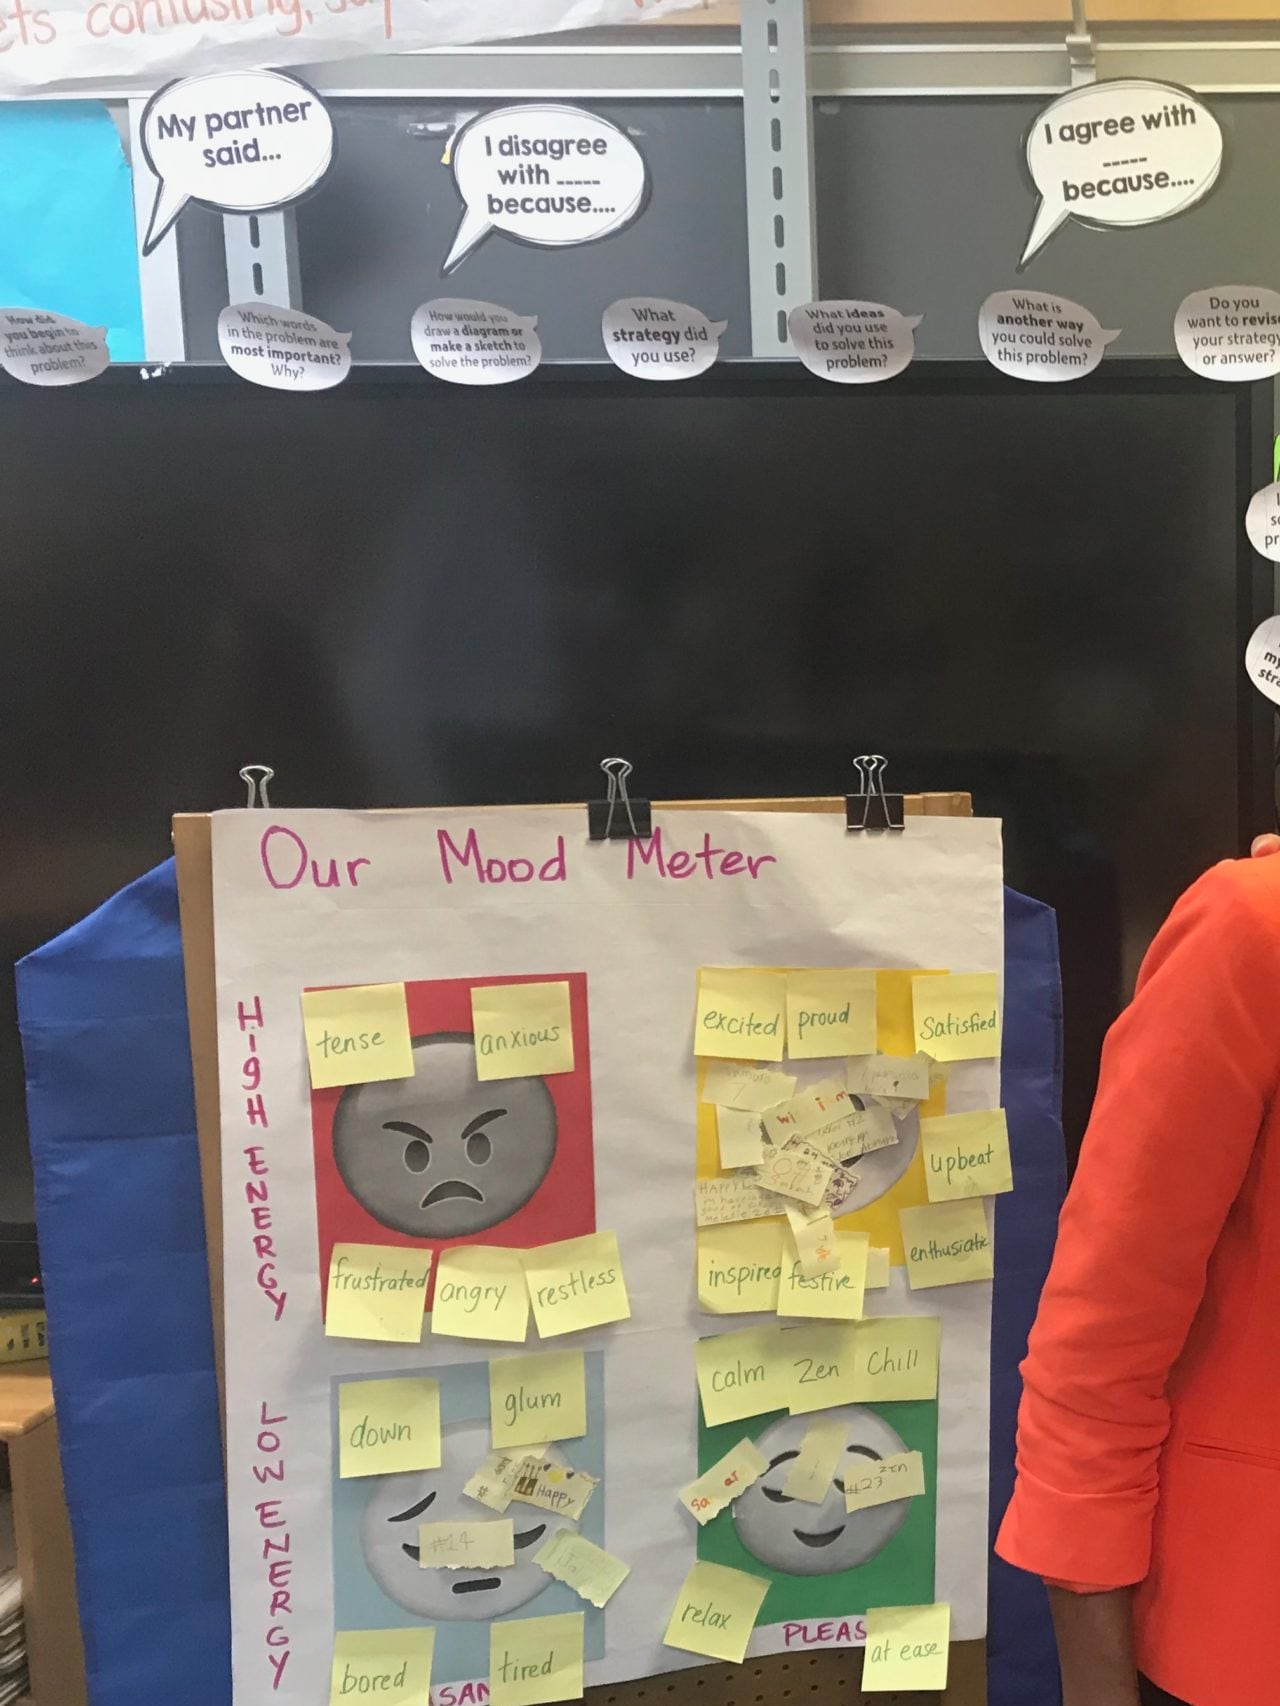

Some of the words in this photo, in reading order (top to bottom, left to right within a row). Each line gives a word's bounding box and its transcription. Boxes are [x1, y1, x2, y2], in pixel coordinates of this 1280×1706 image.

[157, 113, 196, 141] My
[205, 101, 312, 139] partner
[1044, 123, 1053, 144] I
[1058, 115, 1135, 144] agree
[1141, 103, 1196, 130] with
[203, 138, 282, 168] said...
[485, 136, 492, 156] I
[498, 135, 607, 160] disagree
[498, 164, 549, 185] with
[631, 307, 676, 322] What
[805, 309, 844, 319] What
[845, 309, 885, 319] ideas
[1012, 297, 1050, 312] What
[1051, 302, 1063, 314] is
[1209, 297, 1230, 310] Do
[1232, 298, 1261, 312] you
[237, 310, 278, 327] Which
[280, 317, 318, 332] words
[428, 310, 453, 321] How
[455, 311, 487, 322] would
[488, 315, 508, 324] you
[997, 314, 1054, 328] another
[1056, 320, 1085, 333] way
[1187, 315, 1222, 329] want
[1225, 314, 1240, 327] to
[4, 331, 28, 343] you
[28, 327, 64, 340] begin
[64, 327, 79, 336] to
[227, 324, 239, 338] in
[242, 325, 263, 340] the
[265, 331, 316, 347] problem
[318, 340, 340, 350] are
[423, 324, 451, 337] draw
[453, 327, 460, 337] a
[461, 325, 509, 339] diagram
[511, 328, 523, 337] or
[612, 328, 680, 345] strategy
[684, 326, 708, 341] did
[813, 322, 835, 335] did
[836, 325, 862, 336] you
[864, 323, 888, 334] use
[992, 332, 1017, 345] you
[1019, 331, 1056, 346] could
[1059, 334, 1093, 348] solve
[4, 343, 37, 358] think
[39, 342, 73, 354] about
[73, 339, 97, 351] this
[430, 339, 463, 352] make
[464, 343, 472, 352] a
[474, 340, 512, 351] sketch
[513, 341, 526, 352] to
[815, 339, 830, 351] to
[832, 338, 866, 351] solve
[868, 337, 895, 350] this
[1192, 336, 1225, 350] your
[30, 355, 86, 376] problem?
[231, 344, 265, 358] most
[267, 346, 341, 366] important?
[429, 355, 458, 368] solve
[460, 355, 479, 367] the
[481, 354, 531, 369] problem?
[631, 352, 660, 367] you
[663, 347, 696, 363] use?
[826, 353, 889, 373] problem?
[998, 347, 1024, 363] this
[1025, 350, 1089, 366] problem?
[1202, 354, 1217, 365] or
[1220, 348, 1276, 365] answer?
[270, 363, 305, 381] Why?
[1276, 492, 1280, 507] I
[261, 824, 371, 889] Our
[437, 828, 566, 884] Mood
[626, 827, 777, 880] Meter
[702, 1009, 780, 1037] excited
[798, 1003, 849, 1040] proud
[316, 1029, 385, 1056] tense
[480, 1024, 560, 1055] anxious
[243, 1146, 287, 1322] ENERGY
[332, 1257, 429, 1292] frustrated
[439, 1283, 507, 1312] angry
[537, 1268, 617, 1306] restless
[711, 1360, 765, 1392] calm
[867, 1349, 918, 1375] Chill
[505, 1391, 562, 1426] glum
[350, 1416, 411, 1448] down
[252, 1402, 287, 1484] LOW
[536, 1483, 575, 1508] Happy
[845, 1476, 884, 1495] #23
[255, 1500, 291, 1690] ENERGY
[681, 1602, 732, 1630] relax
[871, 1648, 893, 1663] at
[900, 1641, 943, 1661] ease
[497, 1650, 554, 1683] tired
[339, 1662, 407, 1695] bored
